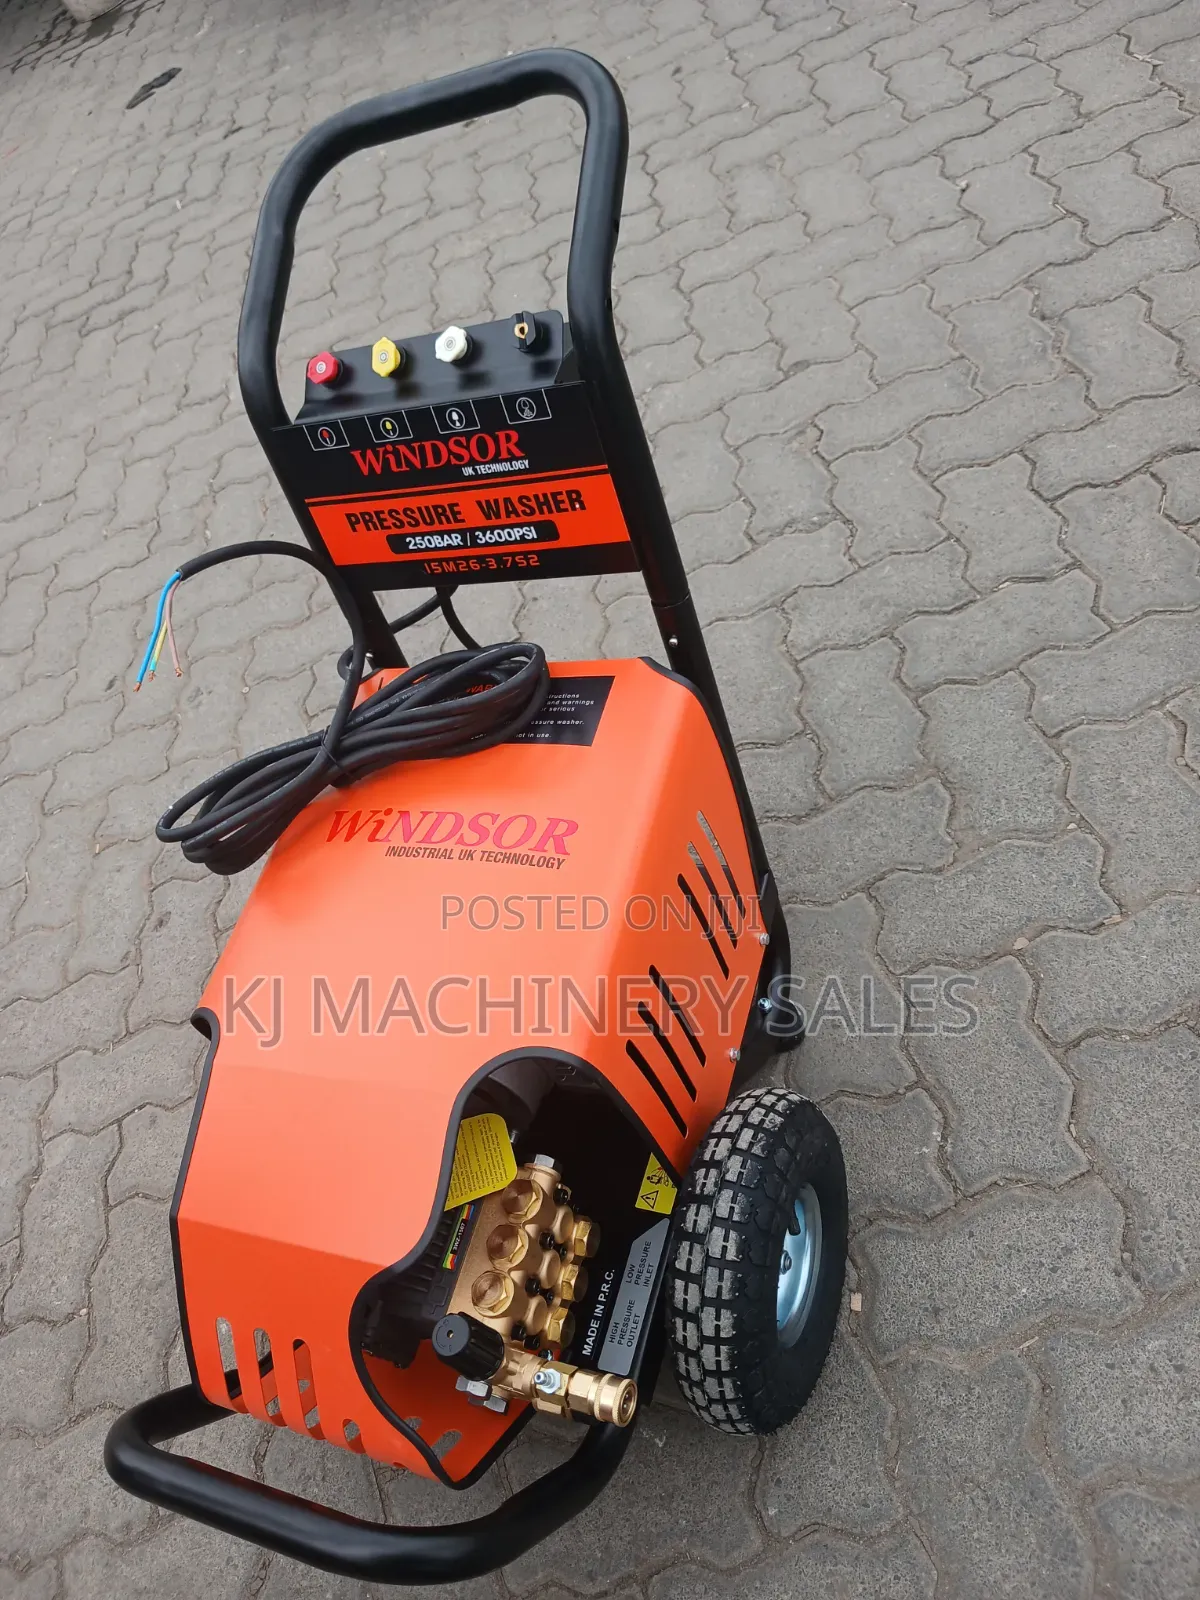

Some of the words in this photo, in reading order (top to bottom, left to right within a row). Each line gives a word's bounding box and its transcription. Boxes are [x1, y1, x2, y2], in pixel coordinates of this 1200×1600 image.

[462, 466, 476, 476] UK
[475, 459, 530, 475] TECHNOLOGY
[345, 502, 466, 533] PRESSURE
[475, 489, 587, 521] WASHER
[405, 534, 463, 550] 250BAR
[475, 526, 538, 544] 3600PSI
[385, 845, 454, 861] INDUSTRIAL
[458, 849, 477, 862] UK
[480, 850, 566, 870] TECHNOLOGY
[626, 1264, 636, 1284] LOW
[634, 1240, 652, 1286] PRESSURE
[643, 1264, 655, 1287] INLET
[598, 1269, 616, 1301] P.R.C.
[594, 1304, 605, 1317] IN
[617, 1299, 636, 1345] PRESSURE
[582, 1319, 600, 1356] MADE
[609, 1322, 620, 1343] HIGH
[626, 1314, 641, 1347] OUTLET
